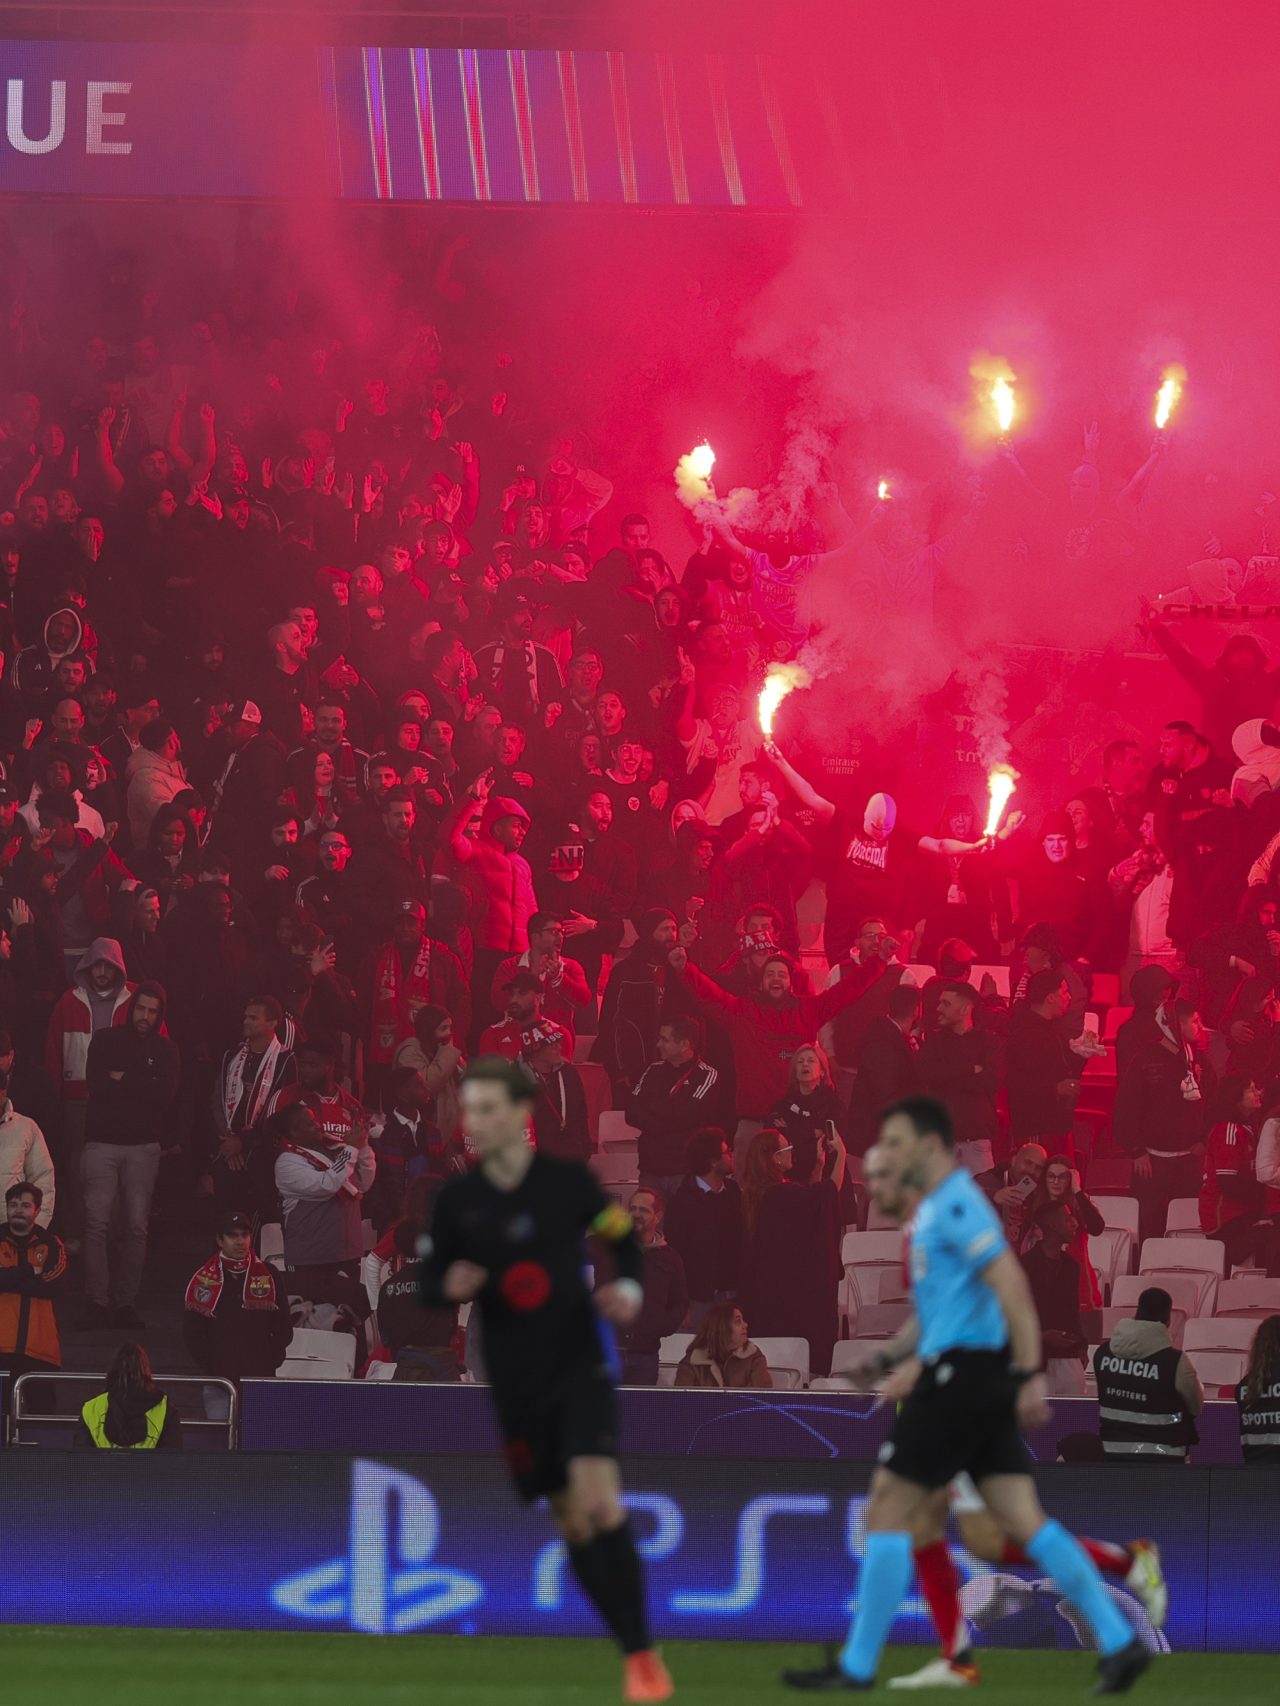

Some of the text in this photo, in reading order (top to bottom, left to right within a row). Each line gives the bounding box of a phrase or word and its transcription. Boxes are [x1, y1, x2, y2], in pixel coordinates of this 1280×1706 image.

[822, 756, 860, 768] Emirates
[395, 1281, 417, 1296] SAGR
[1100, 1355, 1160, 1381] POLICIA
[1106, 1386, 1148, 1402] SPOTTERS
